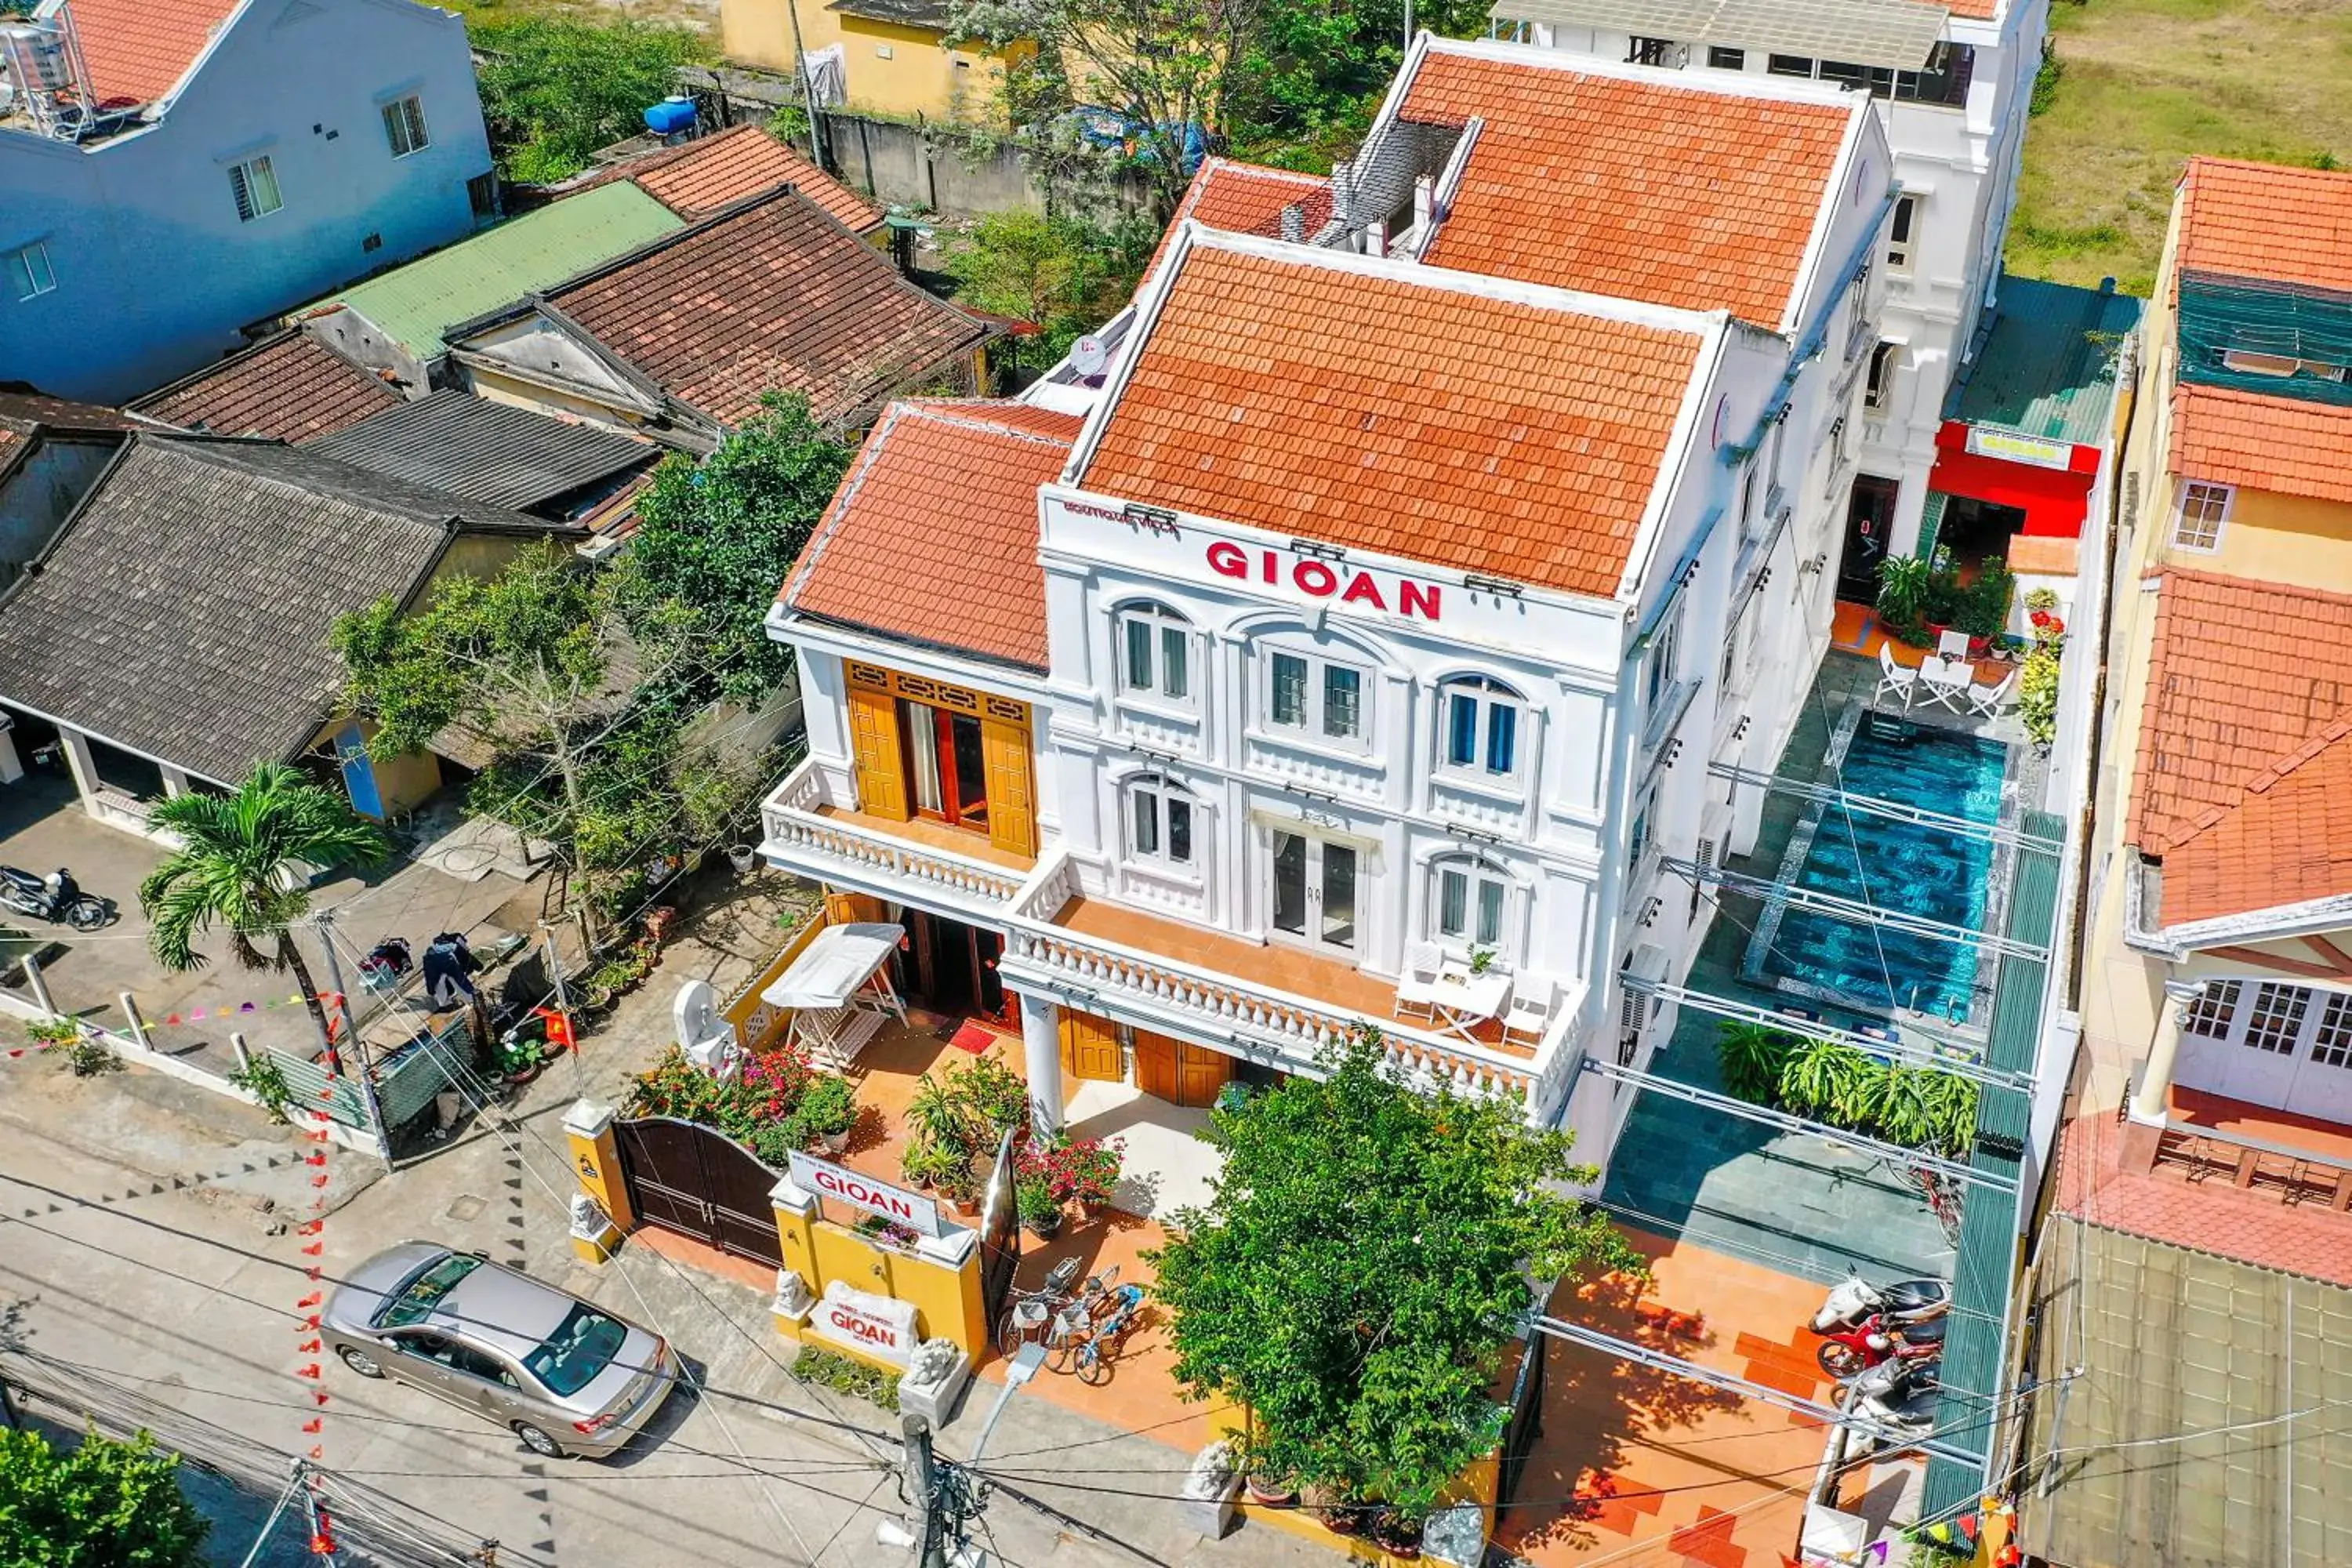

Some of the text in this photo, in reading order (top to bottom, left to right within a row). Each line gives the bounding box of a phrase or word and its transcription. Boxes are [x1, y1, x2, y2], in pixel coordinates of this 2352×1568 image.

[1206, 541, 1442, 620] GIOAN
[815, 1171, 912, 1219] GIOAN
[830, 1310, 896, 1348] GIOAN
